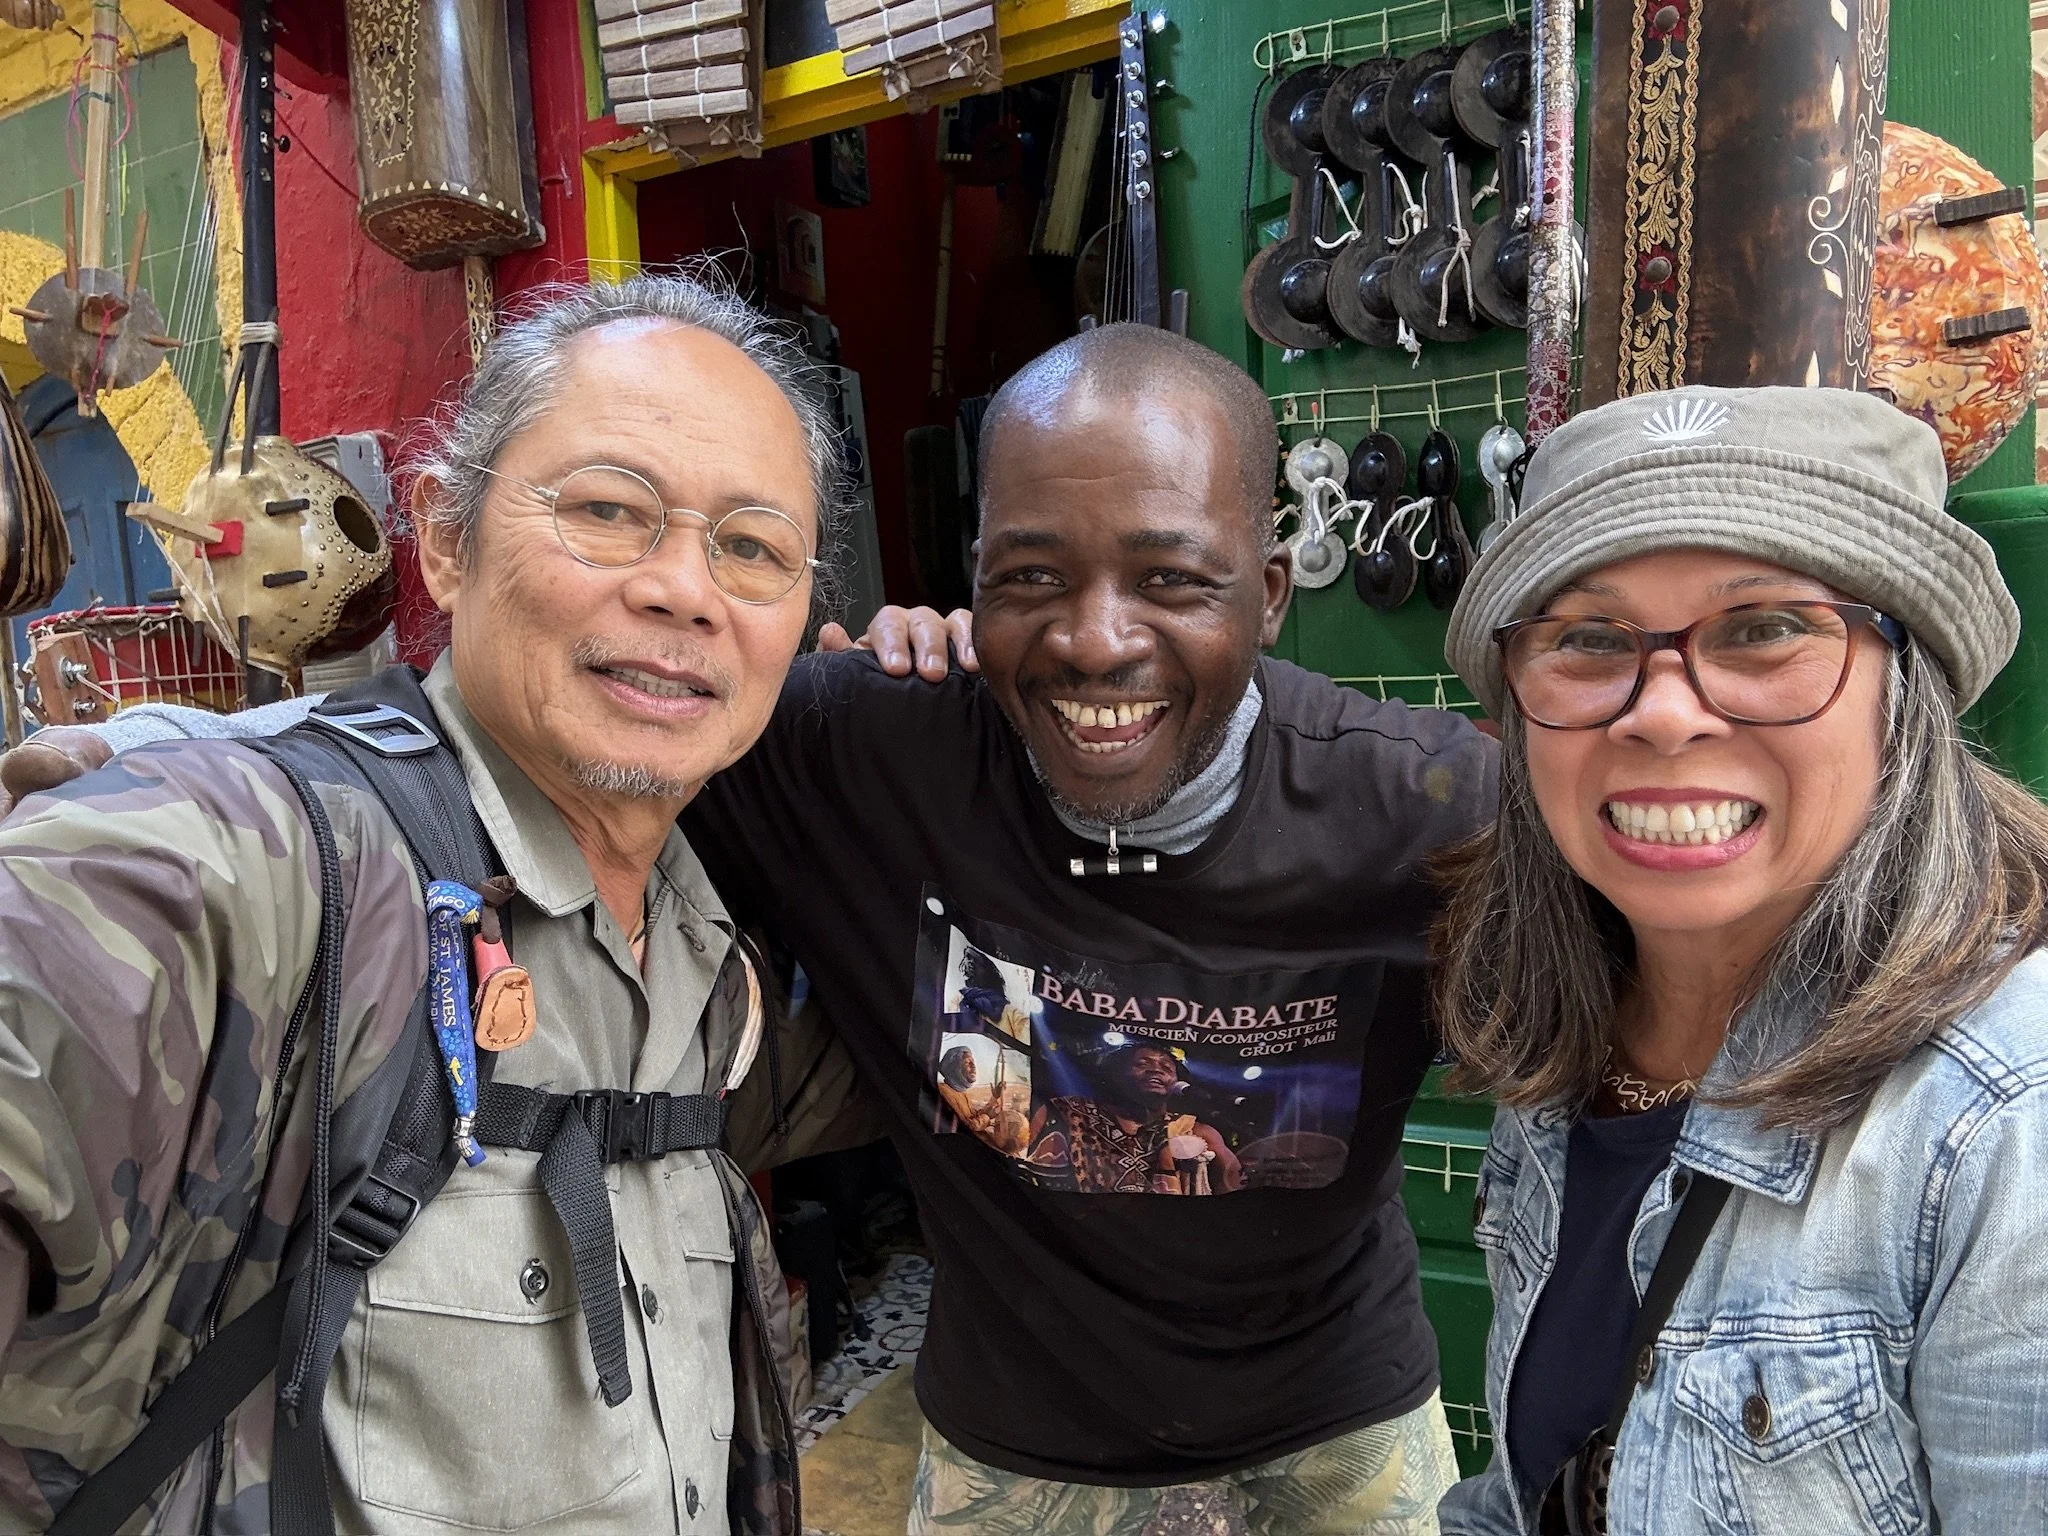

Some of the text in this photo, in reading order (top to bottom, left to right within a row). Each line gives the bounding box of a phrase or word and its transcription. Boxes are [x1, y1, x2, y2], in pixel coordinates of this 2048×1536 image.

[439, 910, 449, 931] OF
[440, 936, 451, 961] ST.
[440, 967, 457, 1028] JAMES
[1039, 973, 1147, 1023] BABA
[1154, 995, 1338, 1030] DIABATE
[1108, 1019, 1338, 1044] MUSICIEN /COMPOSITEUR
[1239, 1031, 1336, 1058] GRIOT Mali
